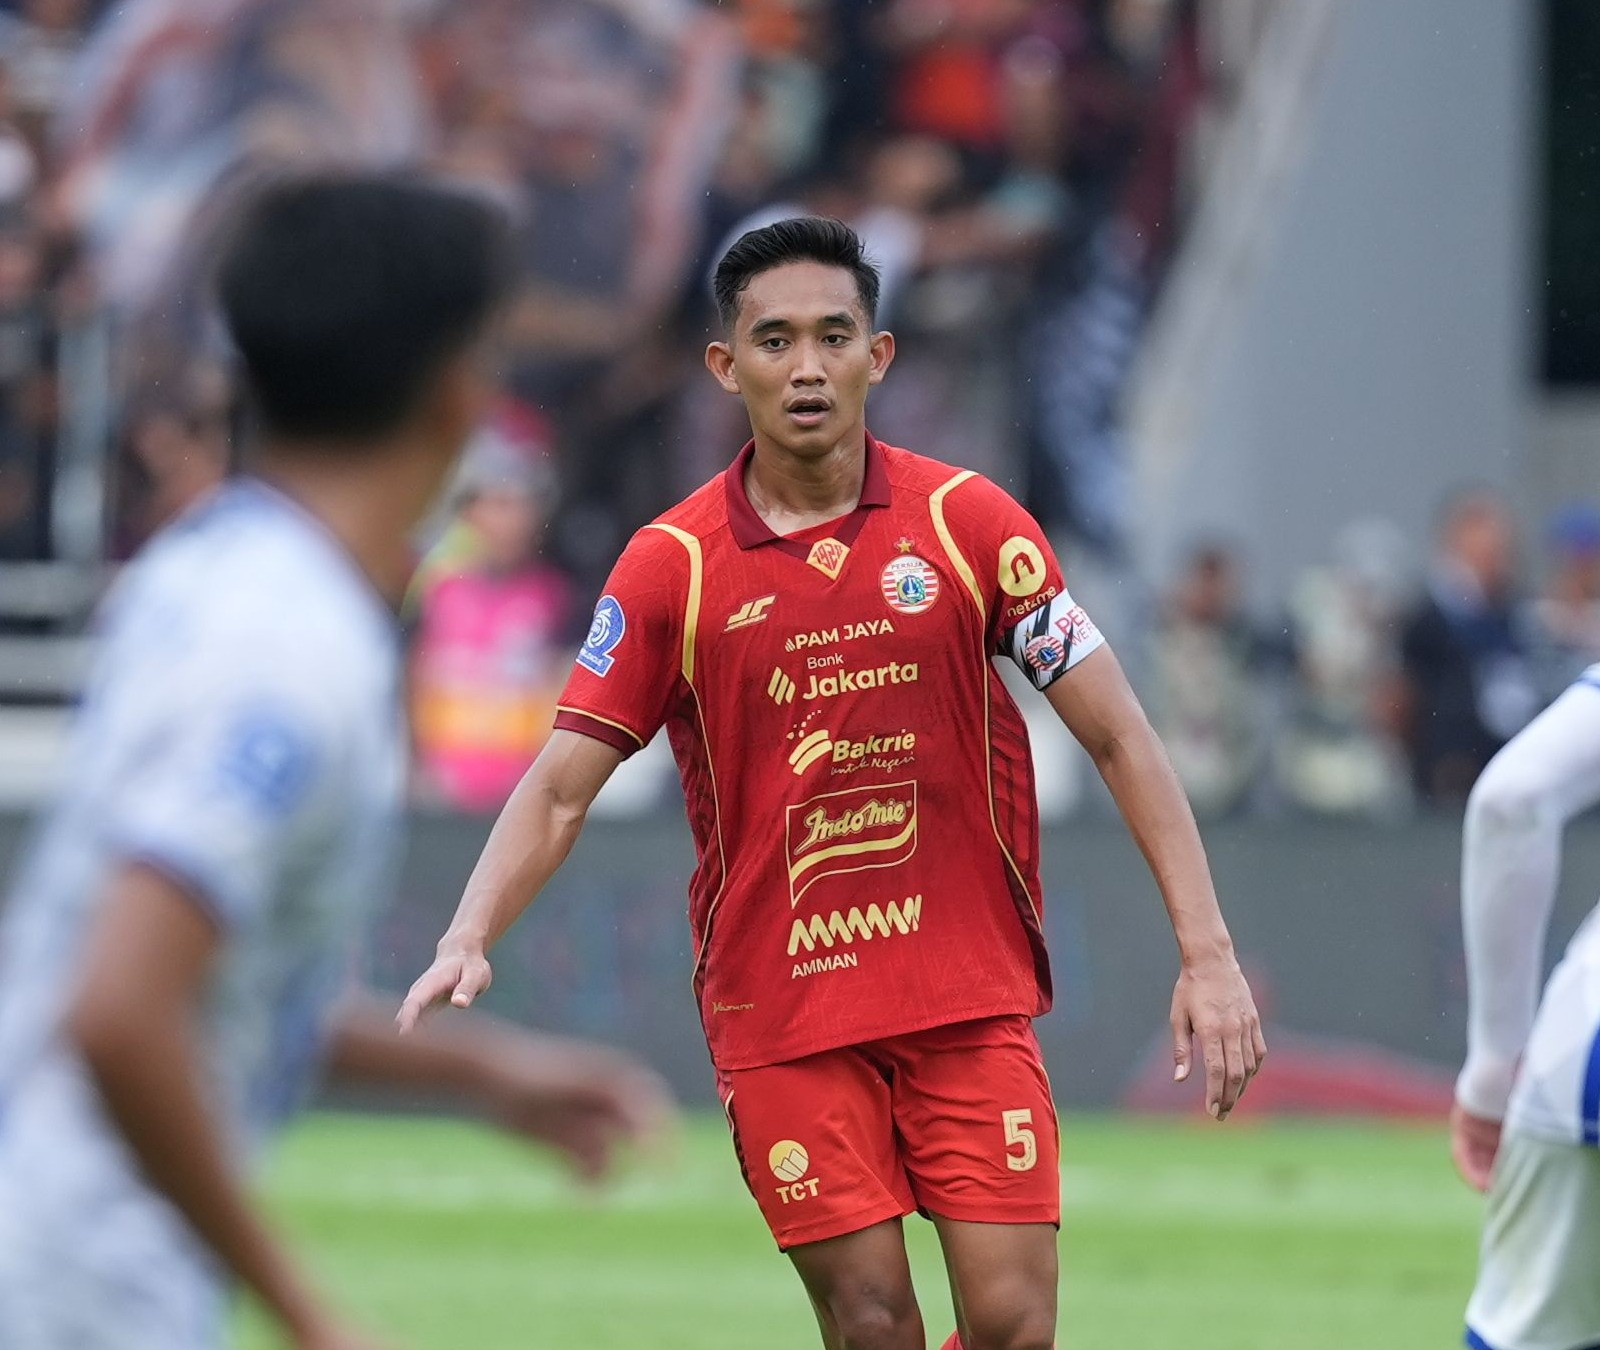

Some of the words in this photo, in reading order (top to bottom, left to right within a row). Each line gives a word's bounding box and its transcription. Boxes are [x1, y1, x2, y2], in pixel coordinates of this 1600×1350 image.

[1007, 586, 1057, 618] netzme
[794, 627, 840, 650] PAM
[843, 618, 895, 641] JAYA
[806, 652, 845, 670] Bank
[802, 661, 919, 700] Jakarta
[832, 728, 916, 763] Bakrie
[794, 799, 906, 855] Indomie
[791, 952, 858, 979] AMMAN
[1002, 1108, 1038, 1172] 5
[775, 1177, 820, 1204] TCT
